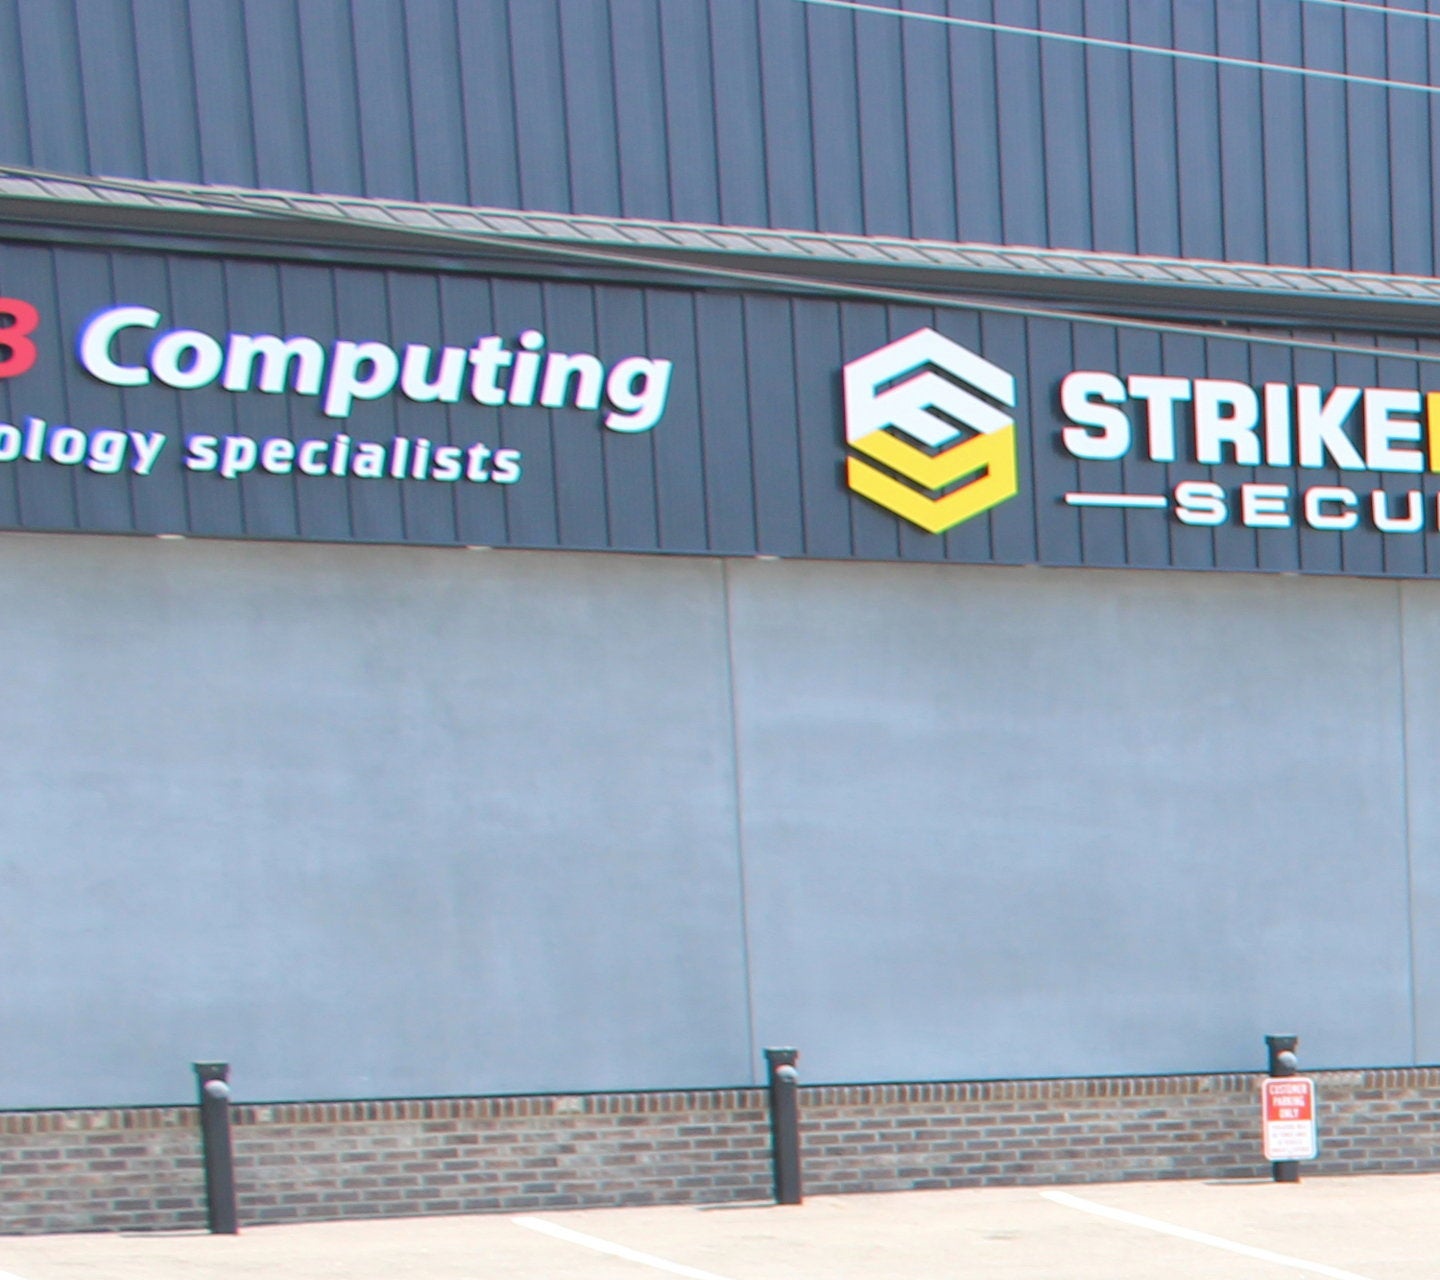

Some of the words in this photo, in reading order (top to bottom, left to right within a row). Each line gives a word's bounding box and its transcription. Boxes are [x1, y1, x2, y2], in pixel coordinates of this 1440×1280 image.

[78, 304, 673, 433] Computing
[184, 430, 522, 485] specialists
[1279, 1108, 1300, 1119] ONLY
